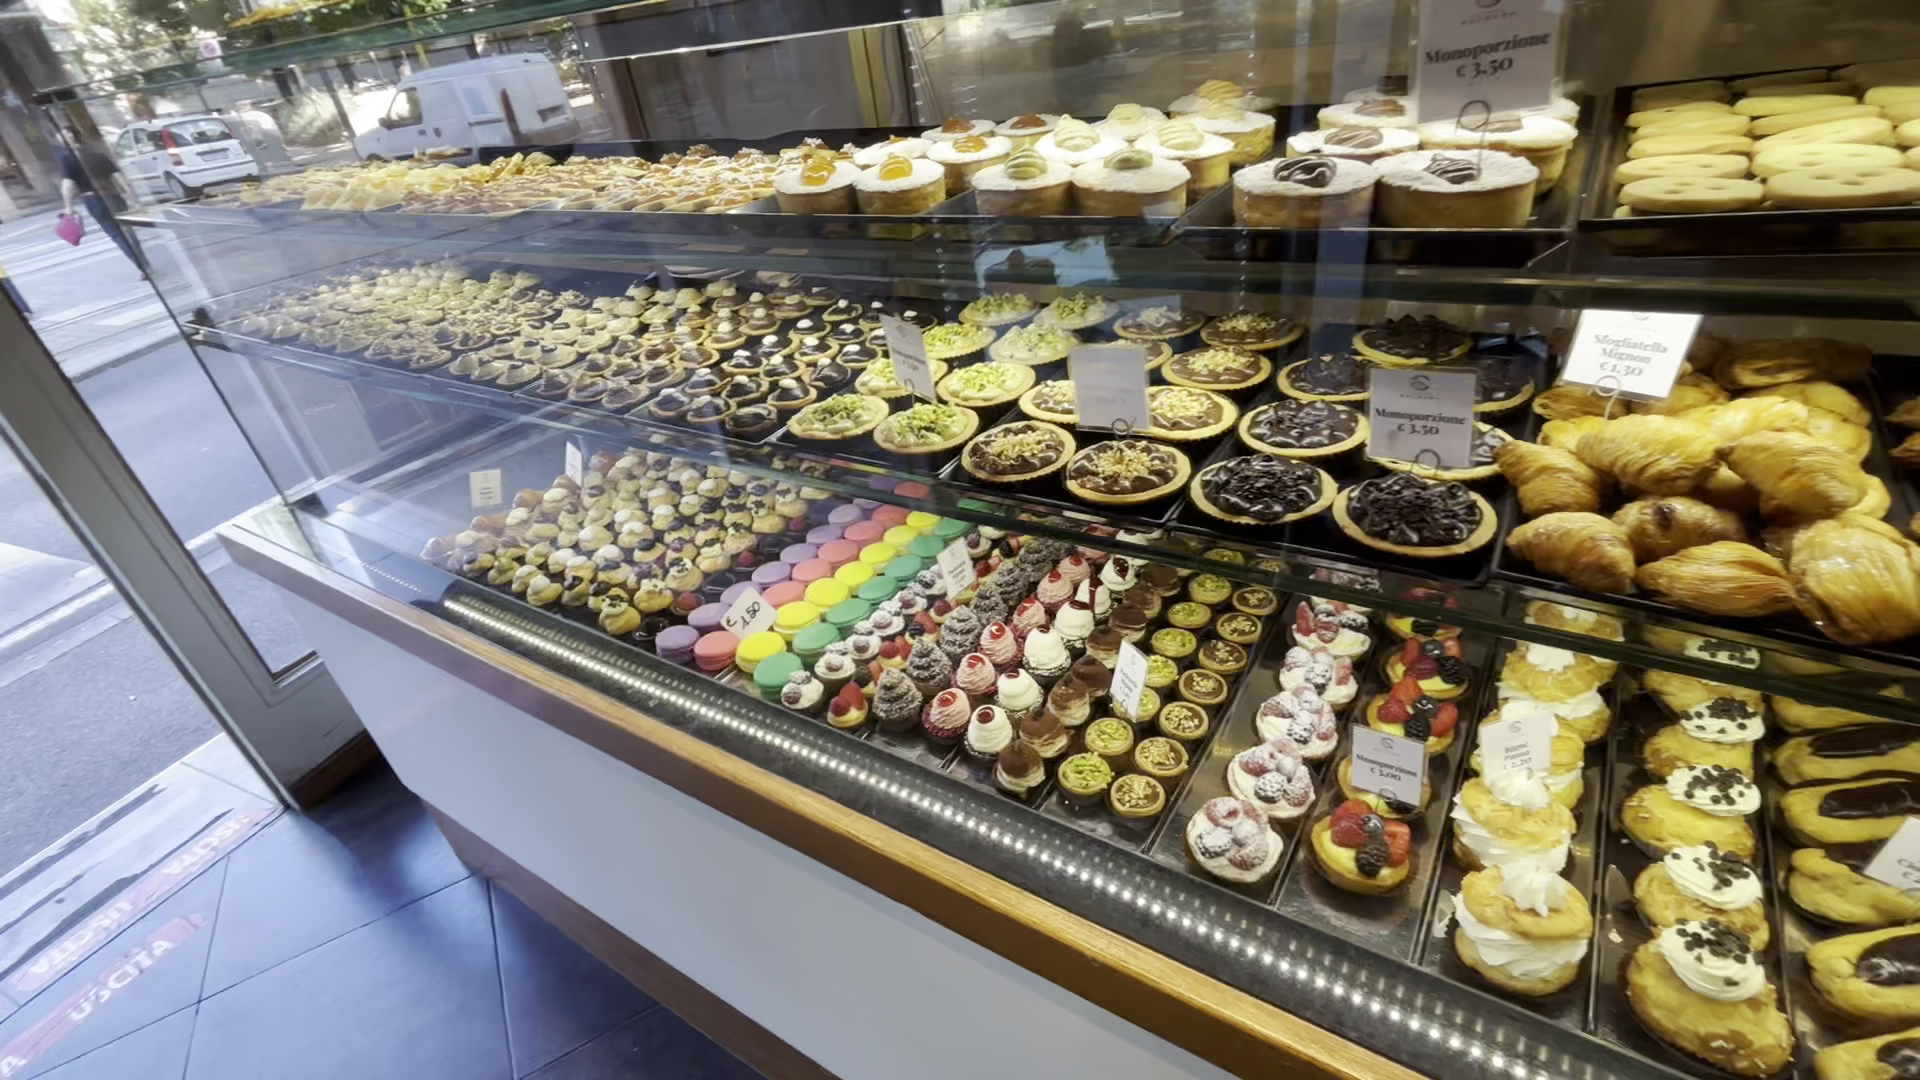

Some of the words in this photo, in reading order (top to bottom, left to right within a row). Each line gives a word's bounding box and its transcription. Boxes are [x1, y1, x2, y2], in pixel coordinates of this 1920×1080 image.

[1424, 32, 1551, 65] Monoporzione
[1472, 57, 1514, 79] 3.50
[1593, 333, 1668, 354] Sfogliatella
[1601, 347, 1652, 365] Mignon
[1610, 363, 1644, 377] 1.30
[1375, 407, 1466, 425] Monoporzione
[1408, 423, 1440, 436] 3.50
[726, 615, 738, 628] €
[67, 939, 175, 1022] USCITA
